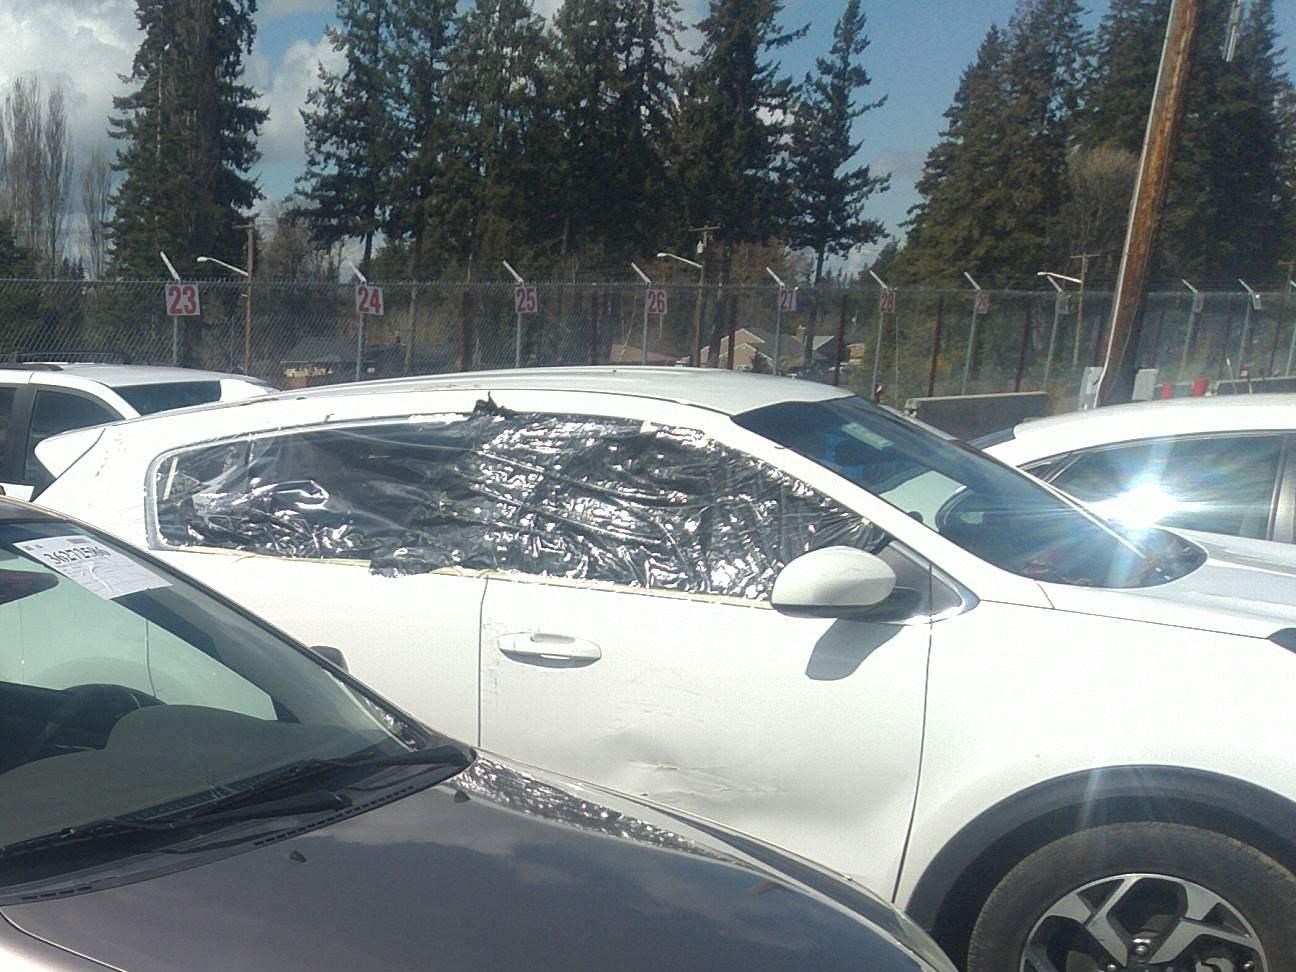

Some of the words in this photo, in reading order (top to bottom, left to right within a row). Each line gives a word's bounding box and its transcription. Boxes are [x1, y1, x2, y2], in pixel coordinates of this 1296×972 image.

[168, 286, 197, 314] 23
[358, 286, 381, 314] 24
[516, 287, 536, 312] 25
[648, 290, 665, 313] 26
